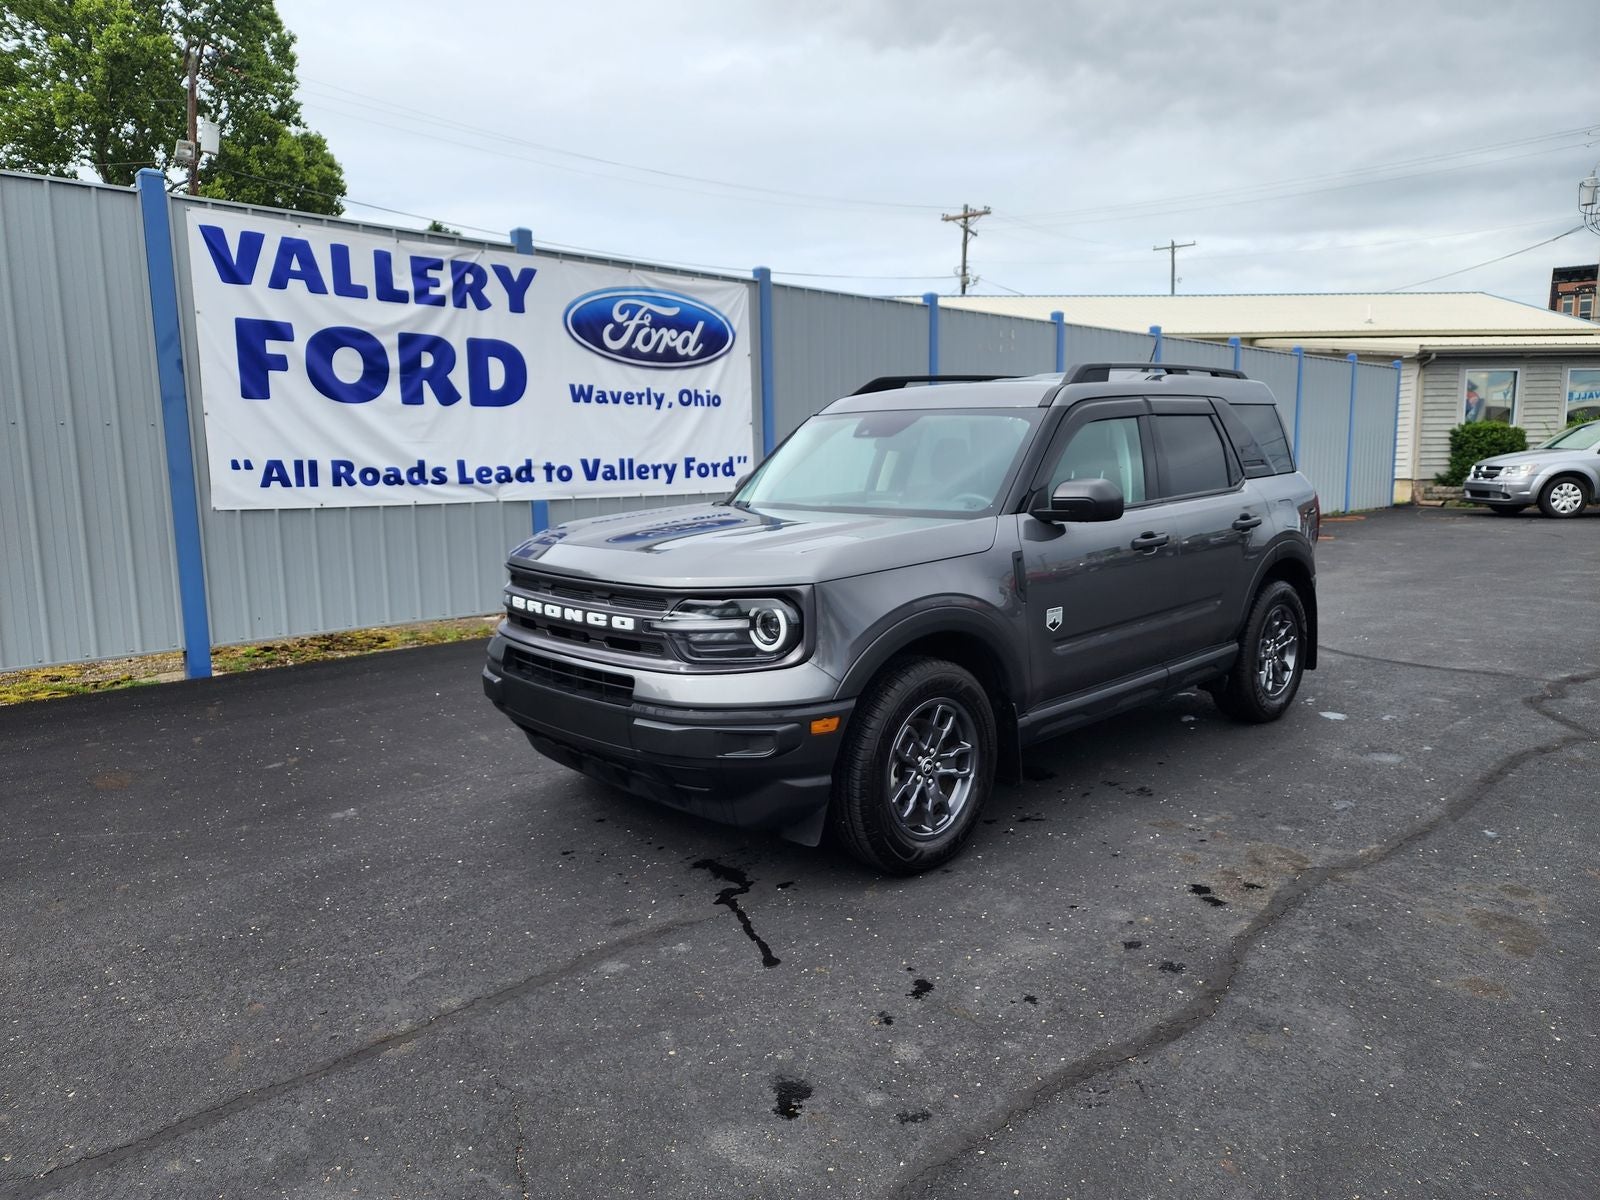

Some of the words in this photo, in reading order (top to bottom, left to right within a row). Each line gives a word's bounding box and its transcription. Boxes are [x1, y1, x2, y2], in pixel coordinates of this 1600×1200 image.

[198, 224, 538, 314] VALLERY
[602, 299, 705, 357] Ford
[234, 316, 528, 408] FORD
[568, 383, 674, 411] Waverly,
[677, 388, 722, 408] Ohio
[330, 459, 449, 488] Roads
[456, 458, 536, 485] Lead
[542, 461, 573, 484] to
[579, 457, 678, 486] Vallery
[512, 595, 635, 631] BRONCO
